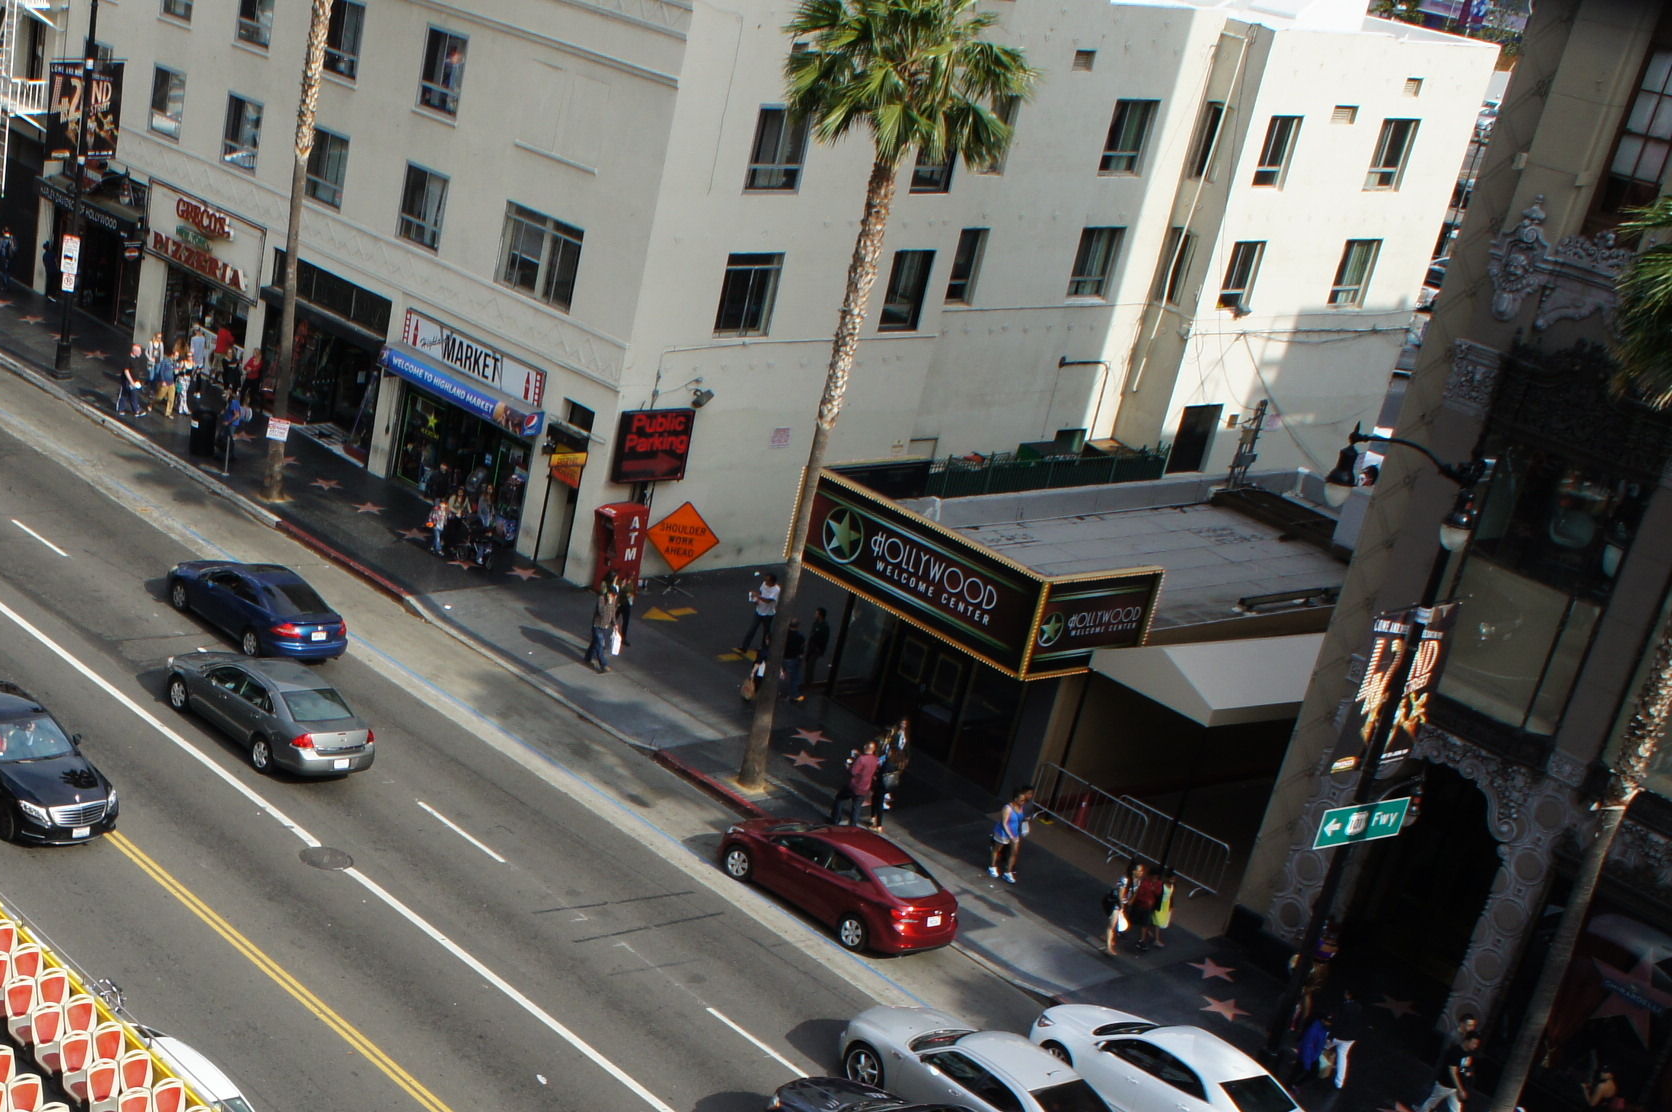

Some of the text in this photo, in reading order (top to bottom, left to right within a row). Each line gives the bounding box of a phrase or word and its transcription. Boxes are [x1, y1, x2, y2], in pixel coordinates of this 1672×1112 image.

[92, 80, 112, 103] ND
[90, 101, 111, 116] STREET
[86, 207, 117, 230] HOLLYWOOD
[153, 231, 247, 291] PIZZERIA
[443, 334, 501, 383] MARKET
[392, 355, 494, 413] WELCOME TO HIGHLAND MARKET
[632, 414, 686, 433] Public
[625, 433, 689, 454] Parking
[659, 522, 707, 536] SHOULDER
[668, 535, 694, 546] WORK
[664, 547, 694, 558] AHEAD
[871, 531, 997, 611] HOLLYWOOD
[876, 559, 990, 626] WELCOME CENTER
[1067, 606, 1141, 628] HOLLYWOOD
[1071, 622, 1136, 637] WELCOME CENTER
[1408, 640, 1438, 678] ND
[1349, 811, 1399, 830] 101 Fwy
